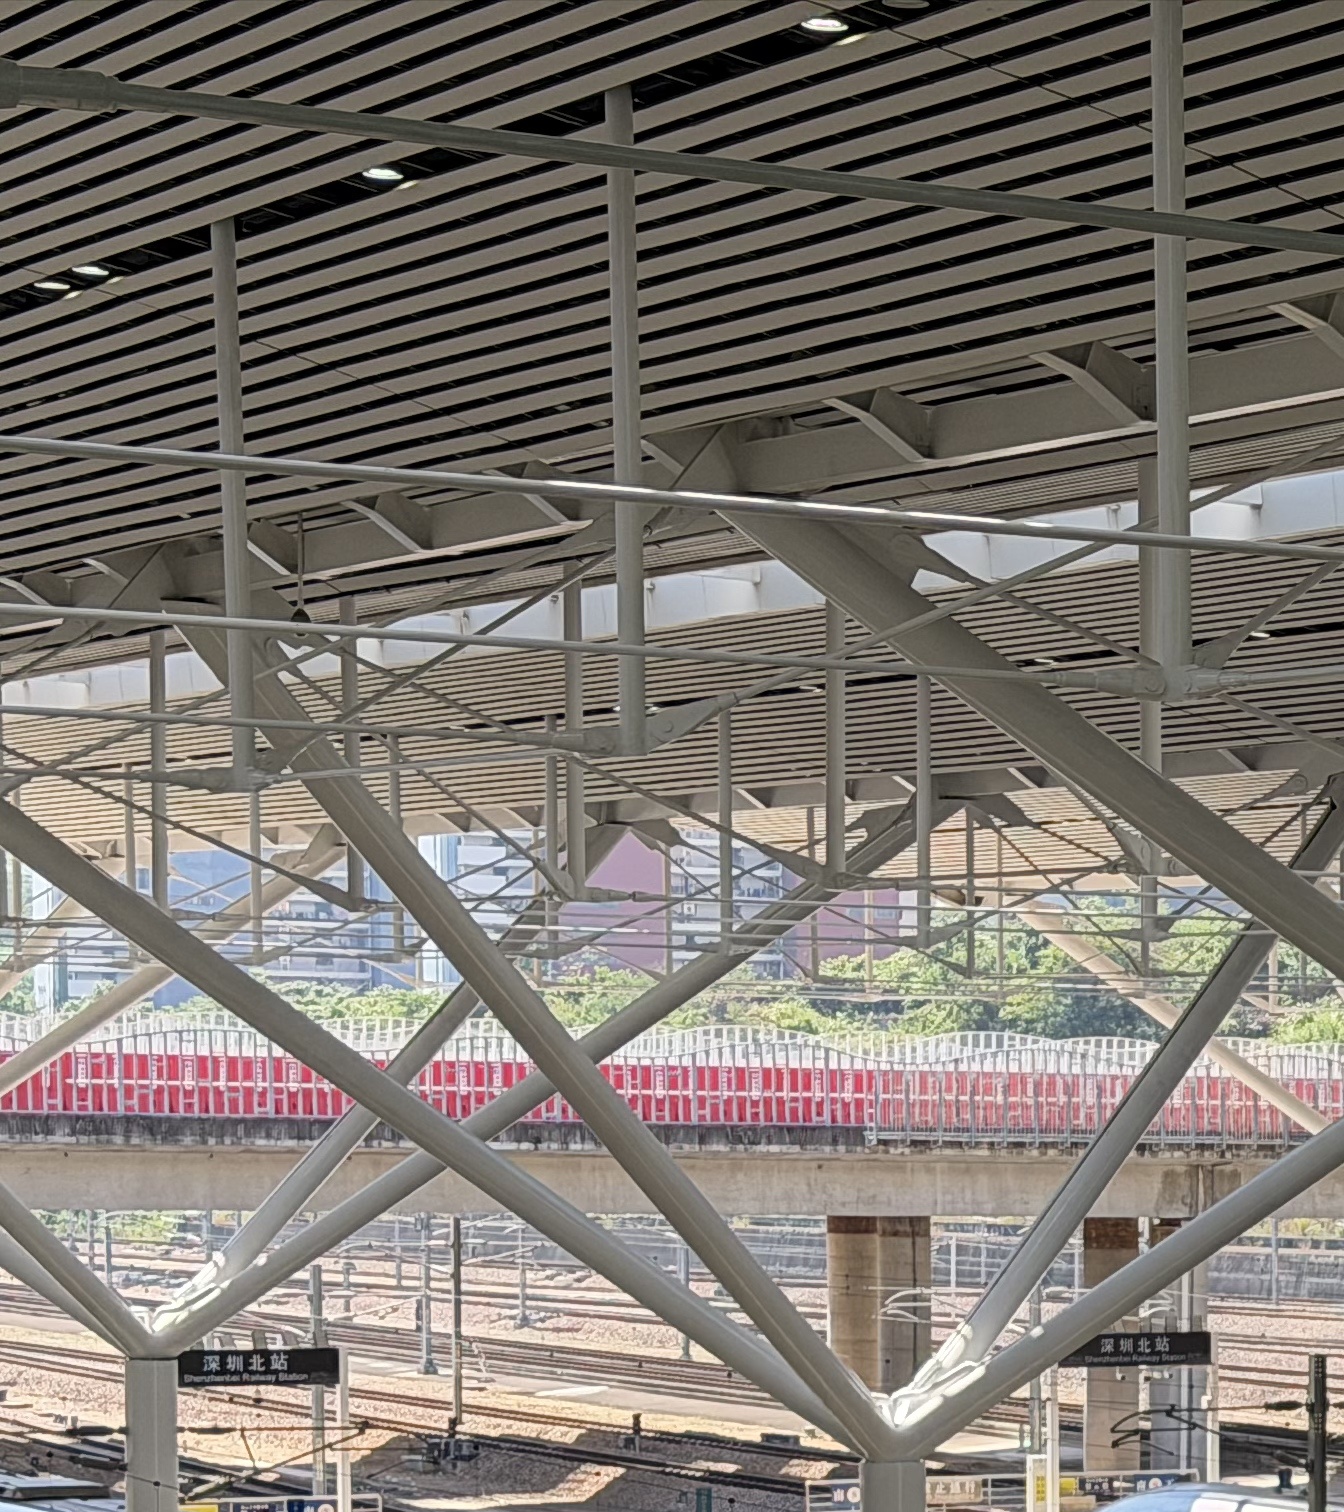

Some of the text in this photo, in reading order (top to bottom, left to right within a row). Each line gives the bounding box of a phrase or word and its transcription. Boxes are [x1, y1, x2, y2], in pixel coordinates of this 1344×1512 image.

[1100, 1336, 1171, 1354] 深圳北站
[203, 1352, 290, 1372] 深圳北站
